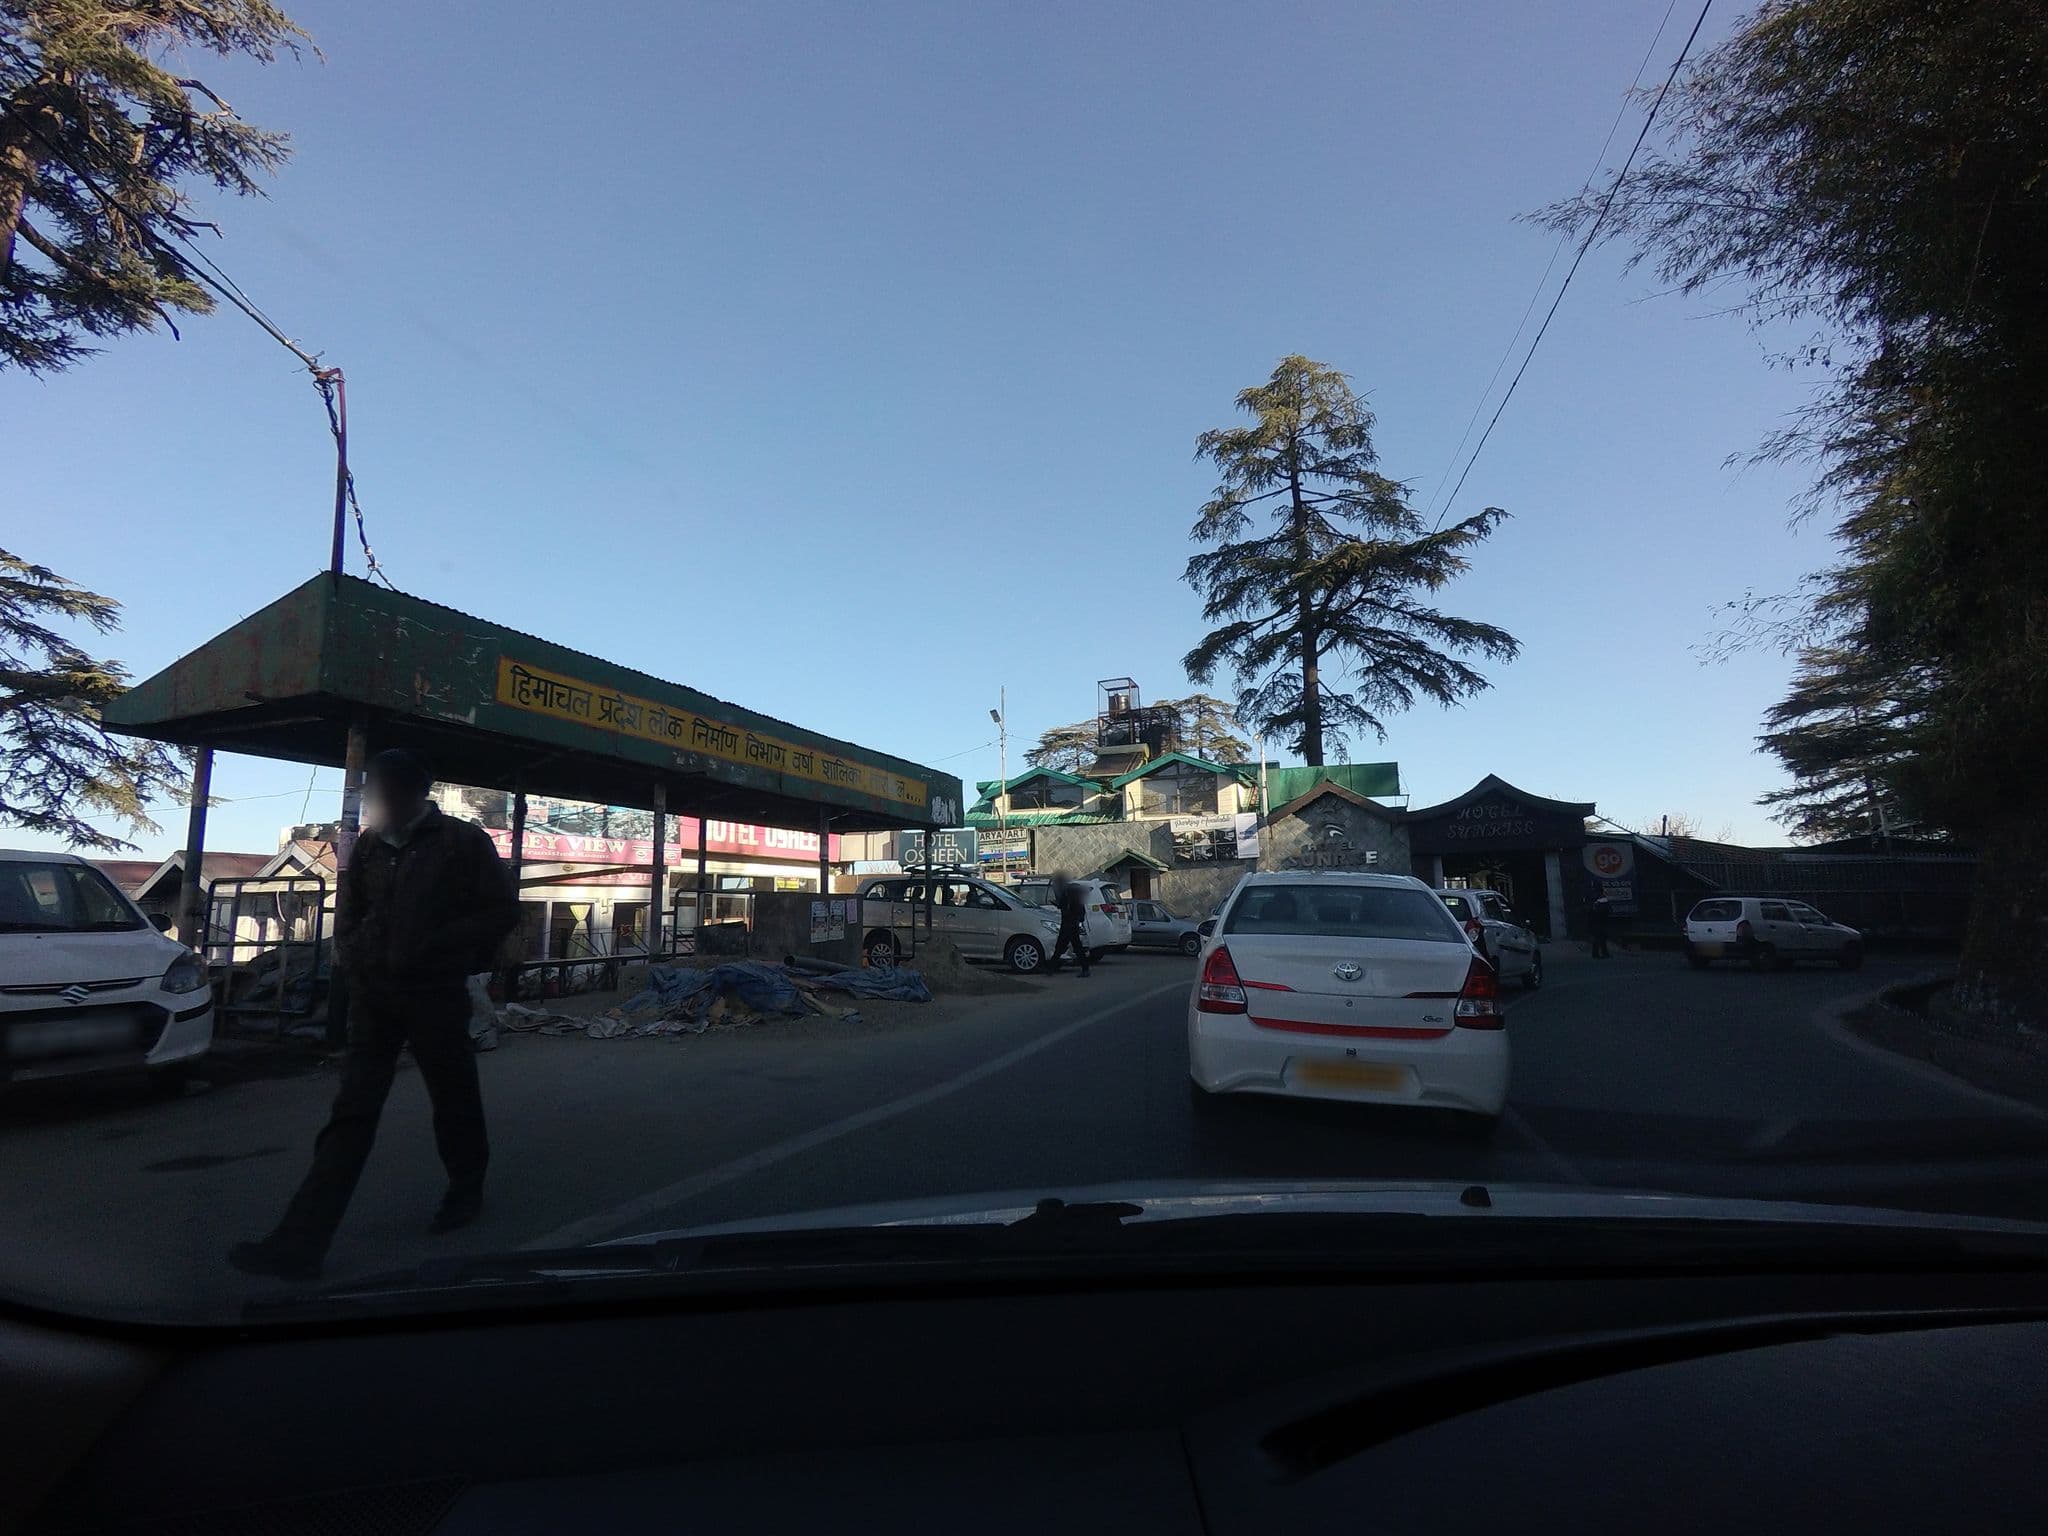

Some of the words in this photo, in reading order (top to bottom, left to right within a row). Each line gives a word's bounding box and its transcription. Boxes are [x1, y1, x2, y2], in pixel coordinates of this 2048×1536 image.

[510, 665, 593, 718] हिमाचल
[598, 694, 644, 730] प्रदेश
[649, 707, 685, 739] लोक
[691, 718, 739, 755] निर्माण
[745, 734, 787, 767] विभाग
[566, 836, 627, 854] VIEW
